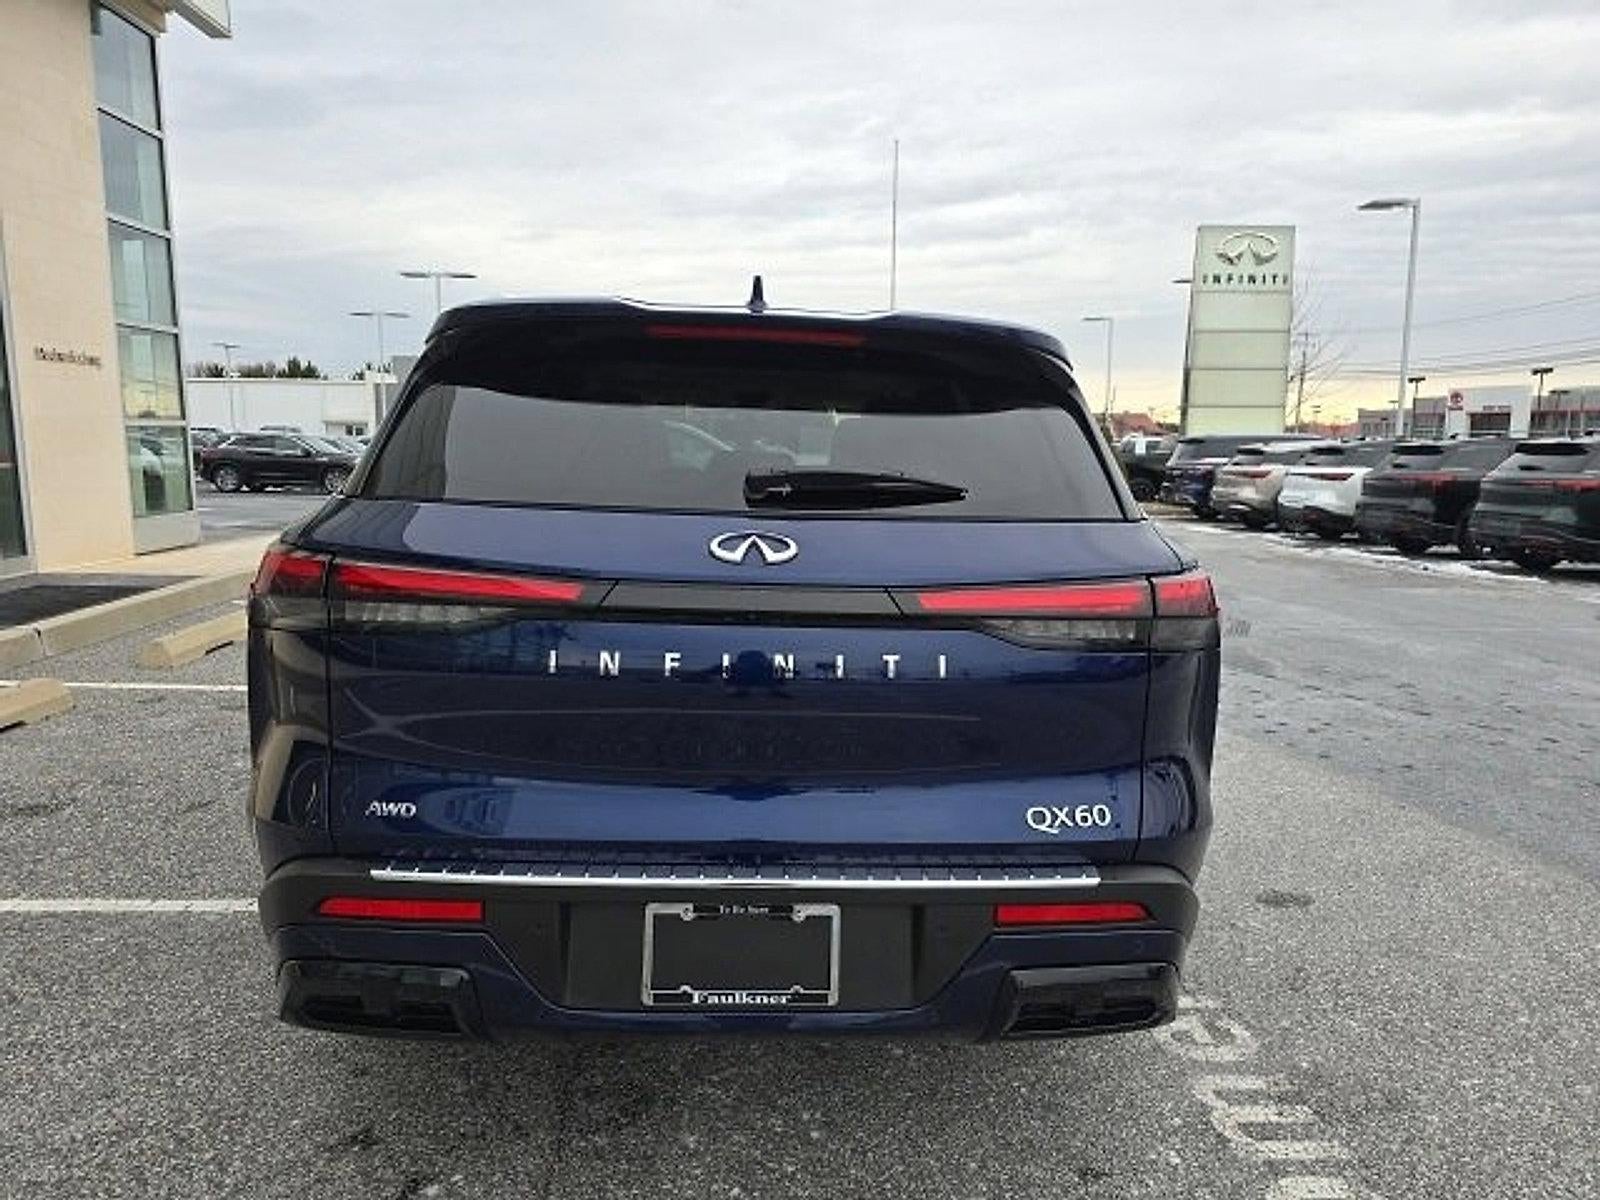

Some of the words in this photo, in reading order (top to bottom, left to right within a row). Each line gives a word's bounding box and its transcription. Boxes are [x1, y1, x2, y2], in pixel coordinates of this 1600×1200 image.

[1202, 273, 1289, 286] INFINITI
[547, 649, 948, 679] INFINITI
[364, 800, 417, 819] AWD
[1026, 804, 1112, 834] QX60
[691, 991, 792, 1005] Faulkner
